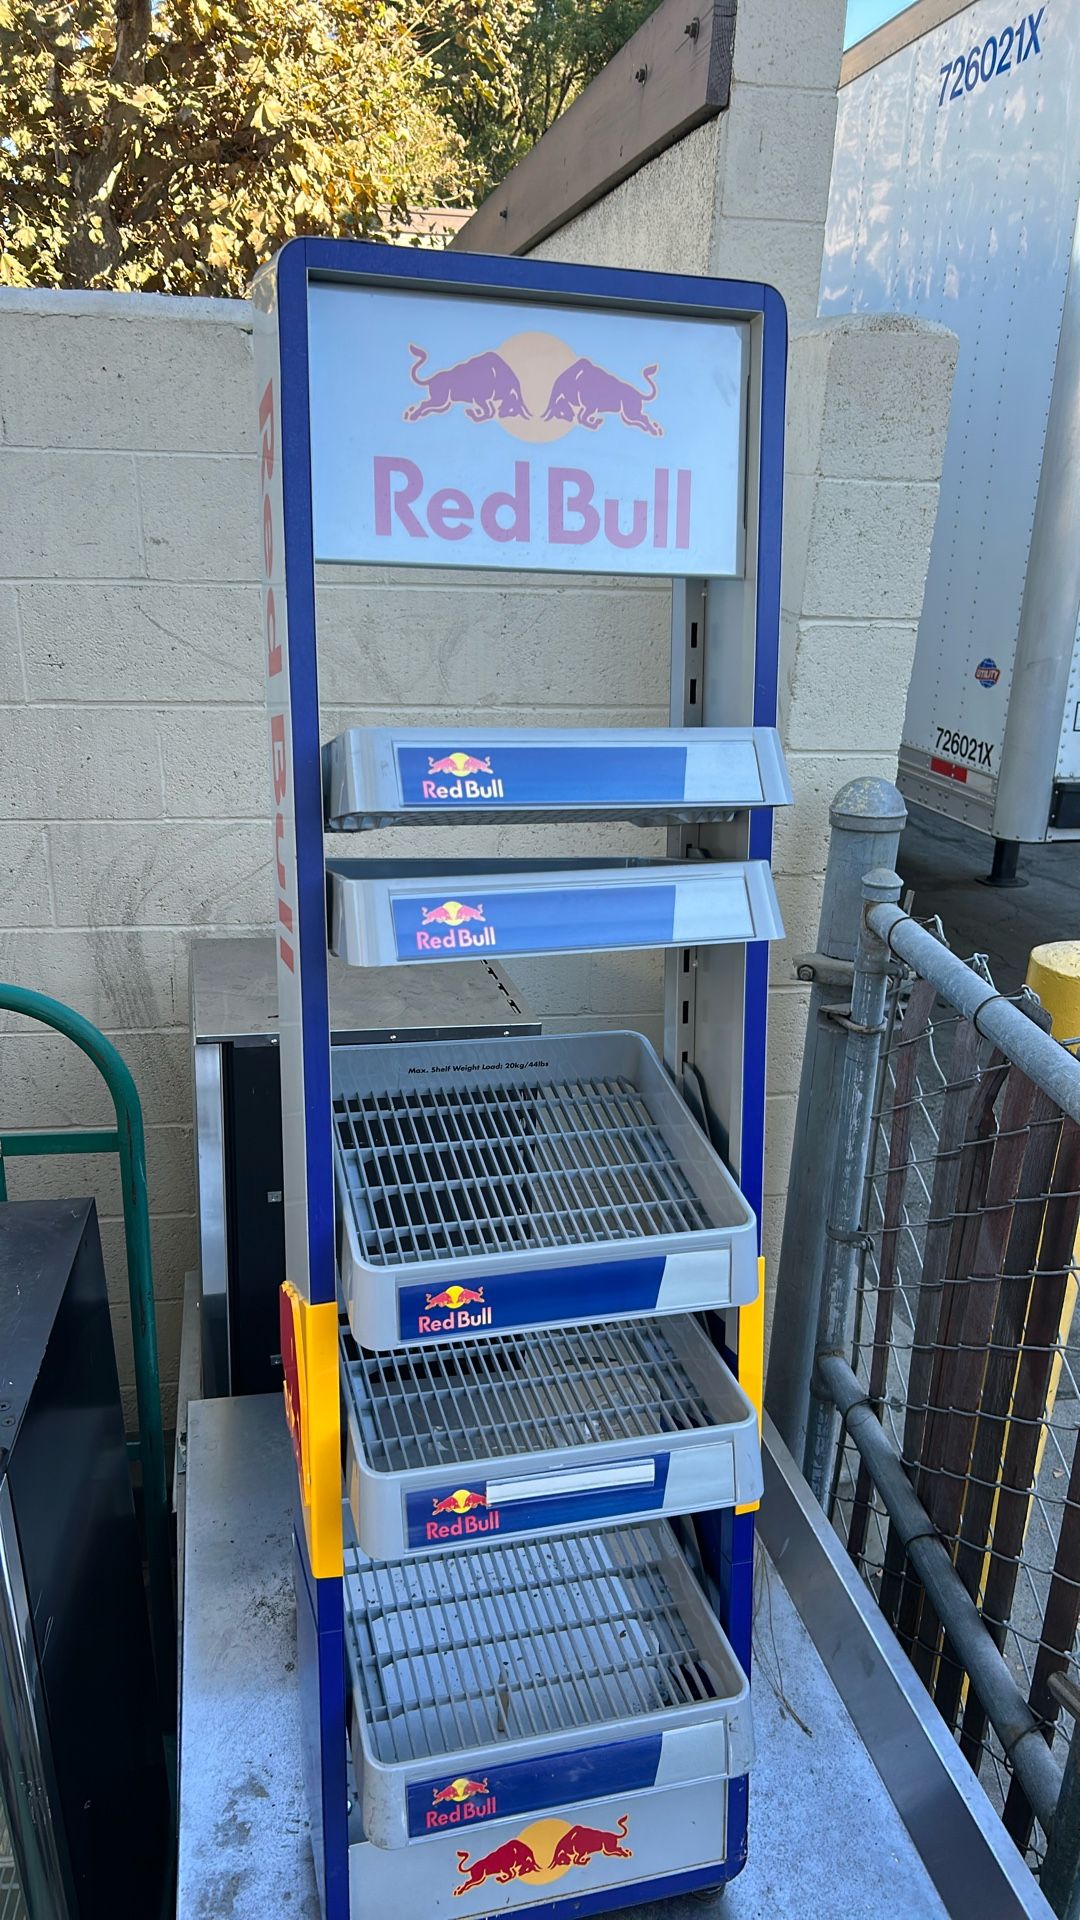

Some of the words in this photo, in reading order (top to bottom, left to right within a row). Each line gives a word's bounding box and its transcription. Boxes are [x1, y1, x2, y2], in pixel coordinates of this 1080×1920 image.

[938, 6, 1045, 107] 726021X
[373, 456, 530, 542] Red
[548, 467, 691, 549] Bull
[259, 378, 282, 677] Red
[271, 714, 294, 973] Bull
[976, 669, 998, 680] UTILITY
[936, 727, 994, 766] 726021X
[422, 779, 463, 799] Red
[466, 779, 504, 799] Bull
[416, 928, 456, 950] Red
[458, 927, 496, 948] Bull
[431, 1065, 451, 1073] Shelf
[453, 1064, 480, 1072] Weight
[482, 1062, 503, 1070] Load:
[505, 1060, 549, 1069] 20kg/44lbs
[418, 1312, 454, 1333] Red
[457, 1306, 492, 1328] Bull
[426, 1518, 461, 1541] Red
[464, 1511, 500, 1534] Bull
[425, 1806, 461, 1829] Red
[463, 1797, 496, 1820] Bull
